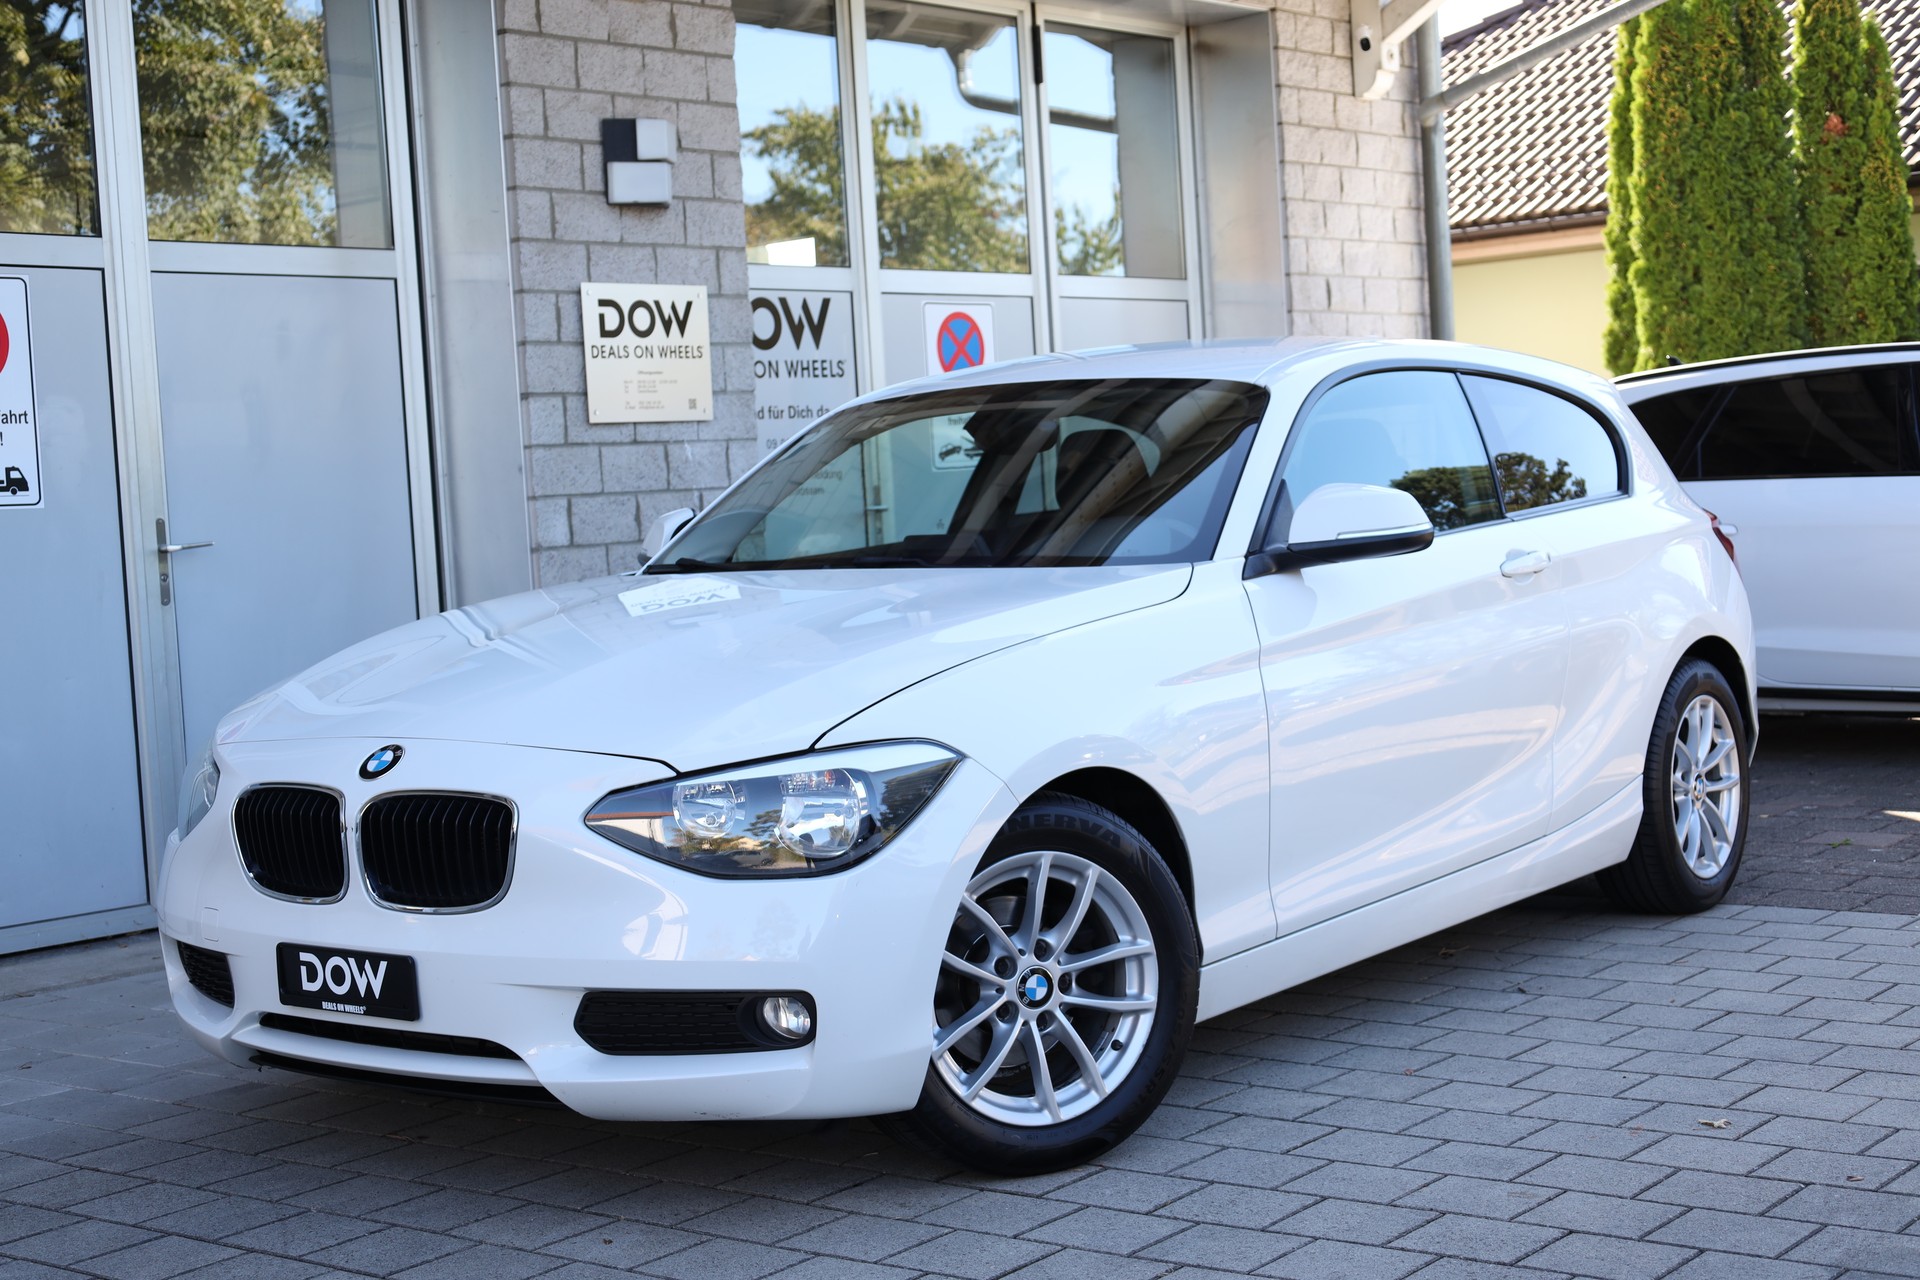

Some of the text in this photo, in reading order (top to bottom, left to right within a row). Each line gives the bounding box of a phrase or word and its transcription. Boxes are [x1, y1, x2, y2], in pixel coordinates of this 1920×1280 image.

[597, 298, 693, 338] DOW
[751, 296, 831, 351] OW
[591, 345, 630, 359] DEALS
[633, 345, 654, 359] ON
[753, 360, 779, 379] ON
[0, 409, 29, 425] ahrt
[757, 405, 765, 420] d
[767, 405, 785, 419] für
[788, 405, 814, 419] Dich
[1001, 813, 1122, 849] NERVA
[298, 951, 388, 1000] DOW
[321, 1001, 337, 1011] DEALS
[337, 1002, 345, 1012] ON
